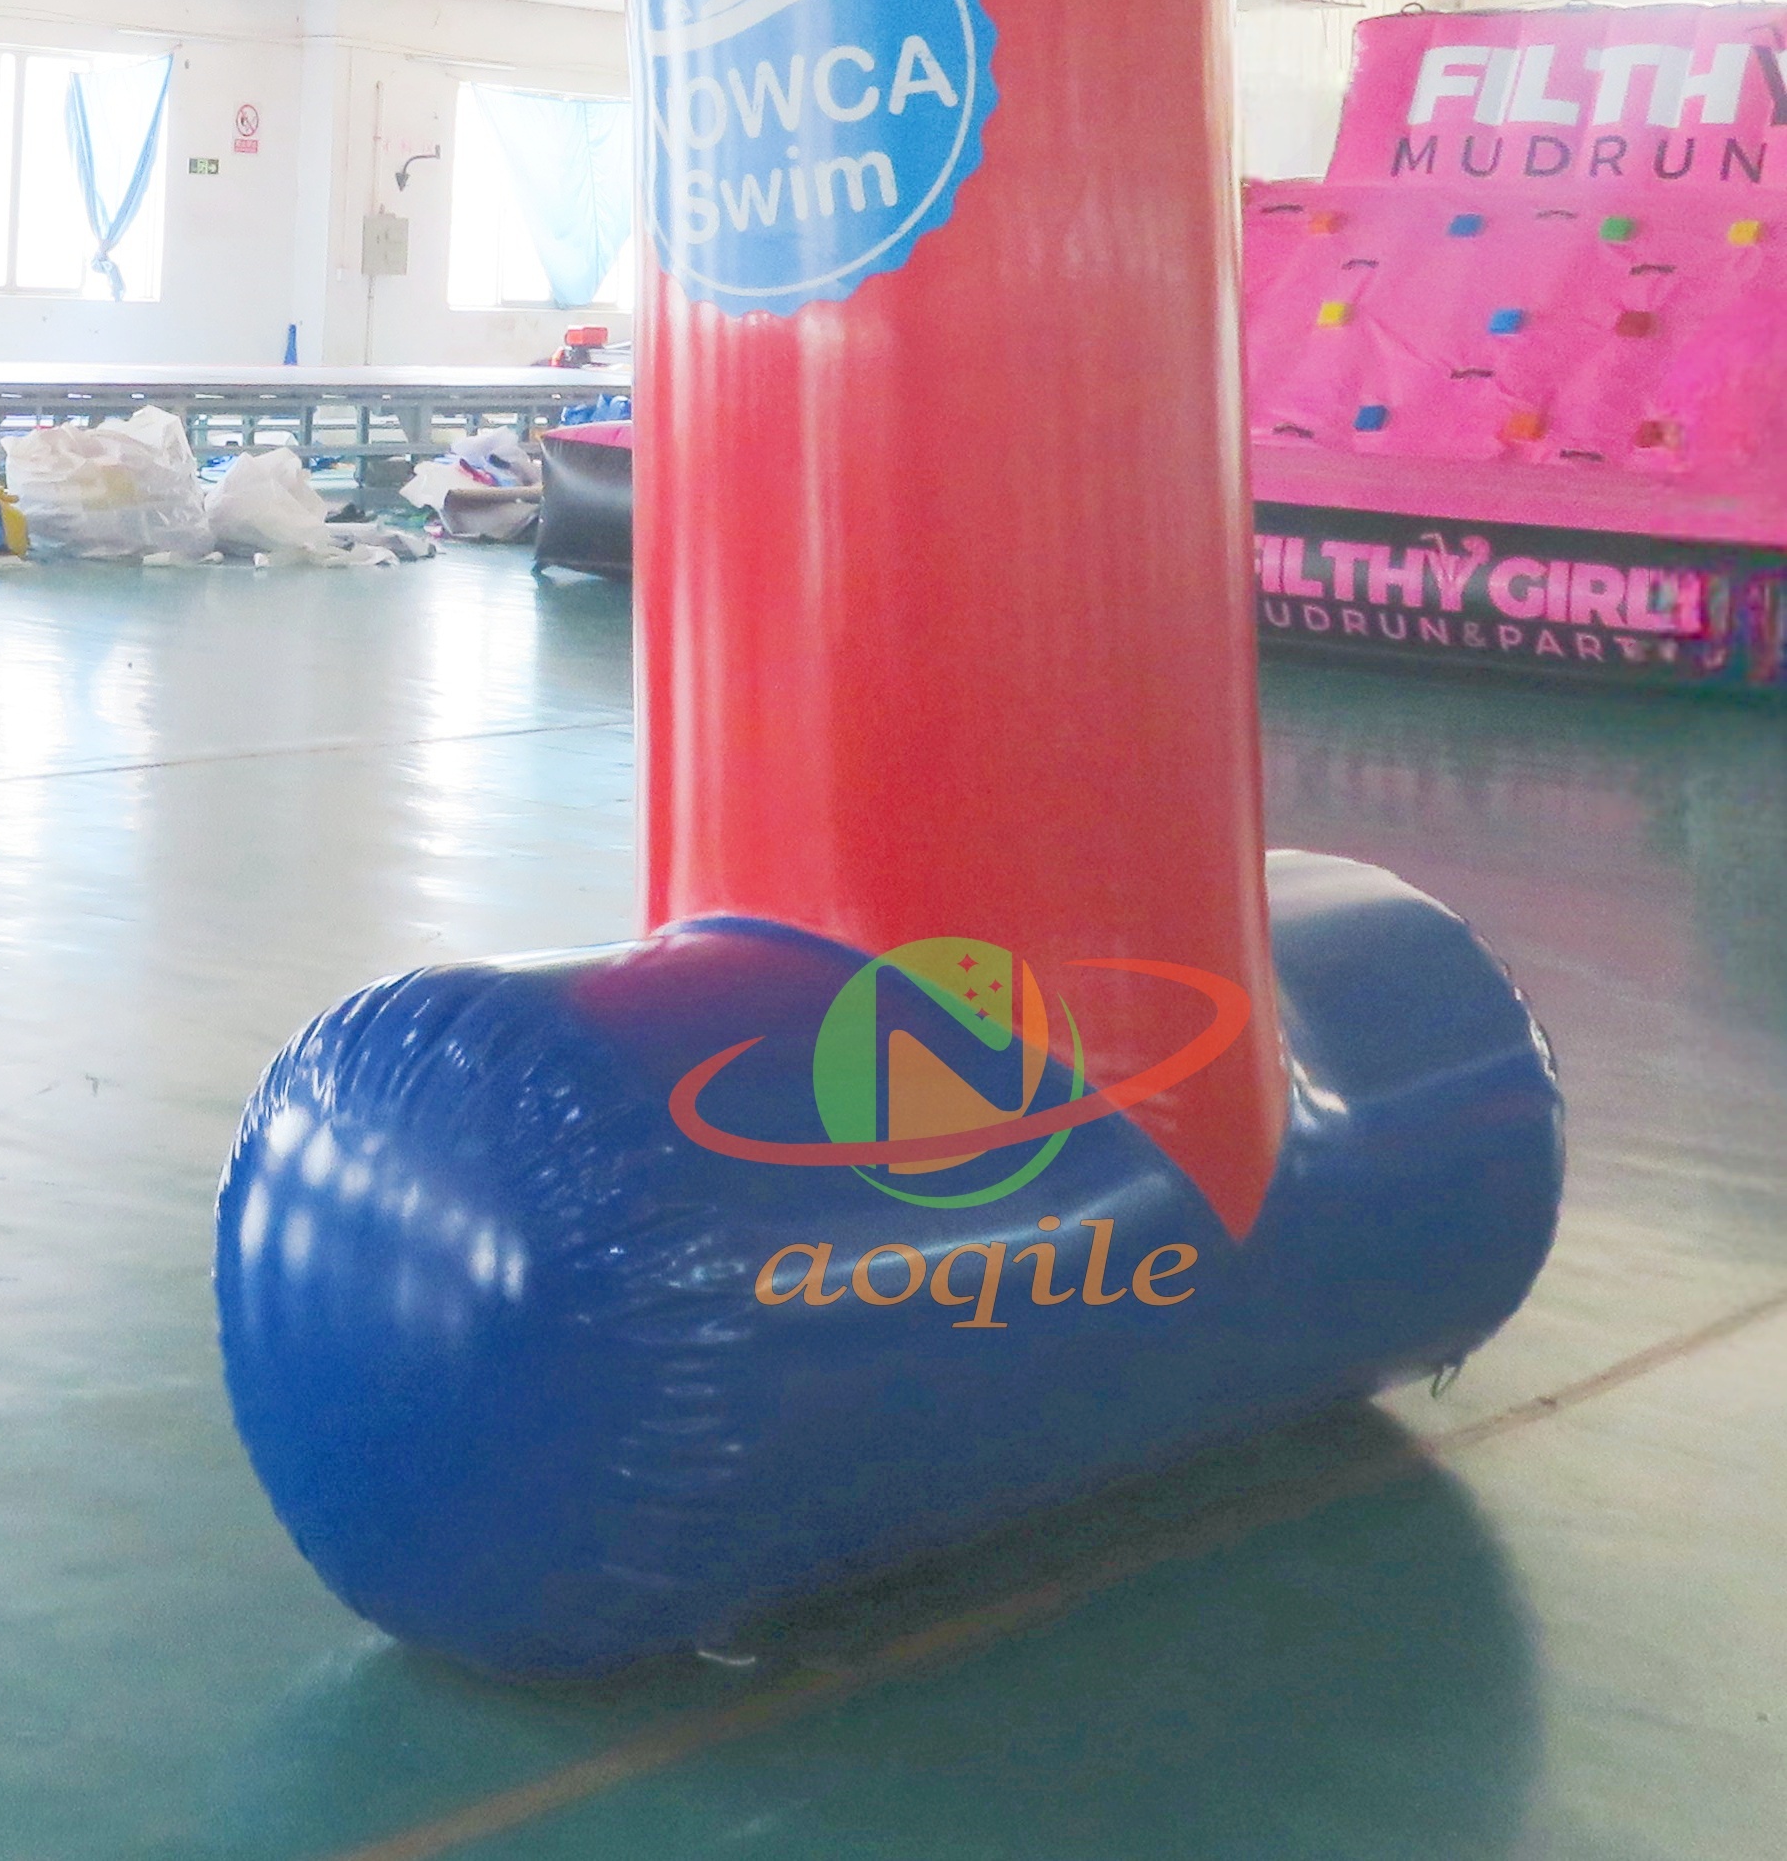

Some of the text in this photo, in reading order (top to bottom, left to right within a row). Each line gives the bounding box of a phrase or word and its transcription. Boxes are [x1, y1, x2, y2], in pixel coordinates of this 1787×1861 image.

[677, 144, 898, 245] Swim
[1390, 134, 1768, 184] MUDRUN
[1254, 533, 1490, 612] ILTHY
